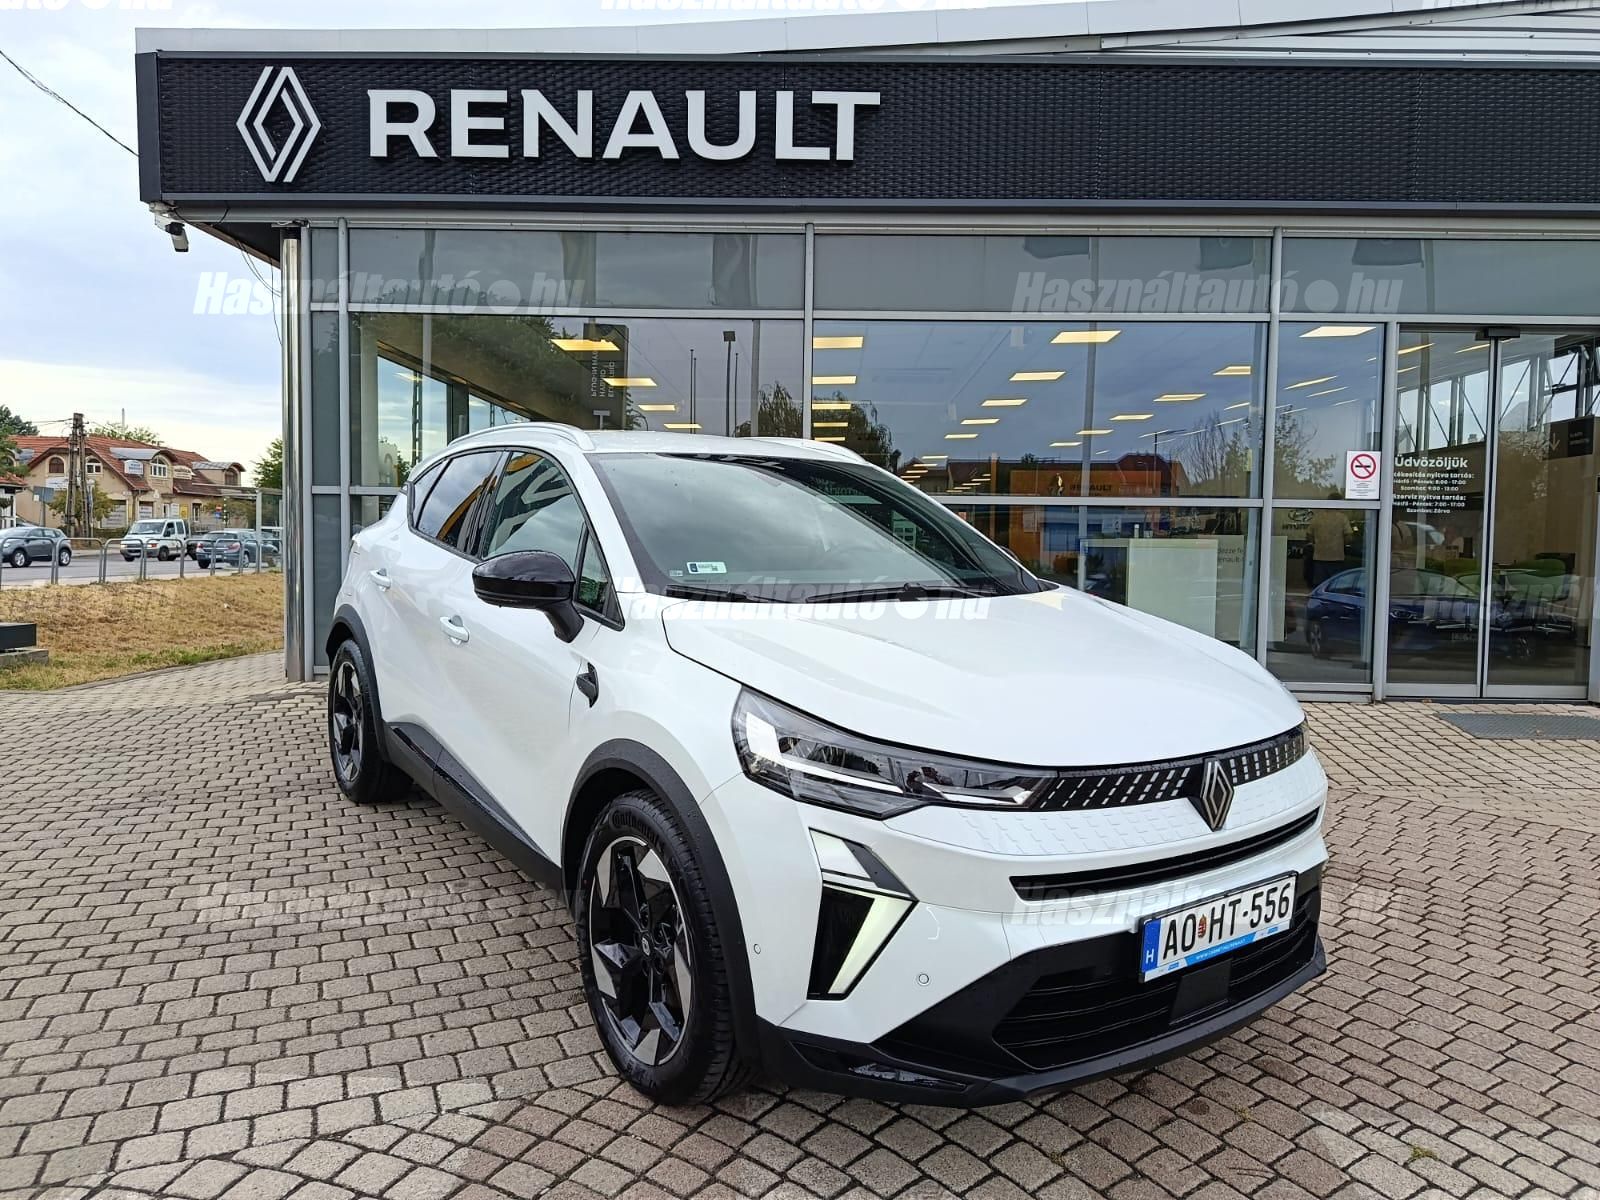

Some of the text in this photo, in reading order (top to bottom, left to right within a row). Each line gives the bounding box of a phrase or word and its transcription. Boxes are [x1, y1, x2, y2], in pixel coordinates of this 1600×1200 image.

[367, 88, 881, 162] RENAULT
[1394, 454, 1468, 470] Üdvözöljük
[1393, 471, 1426, 479] tékesítés
[1145, 948, 1155, 964] H
